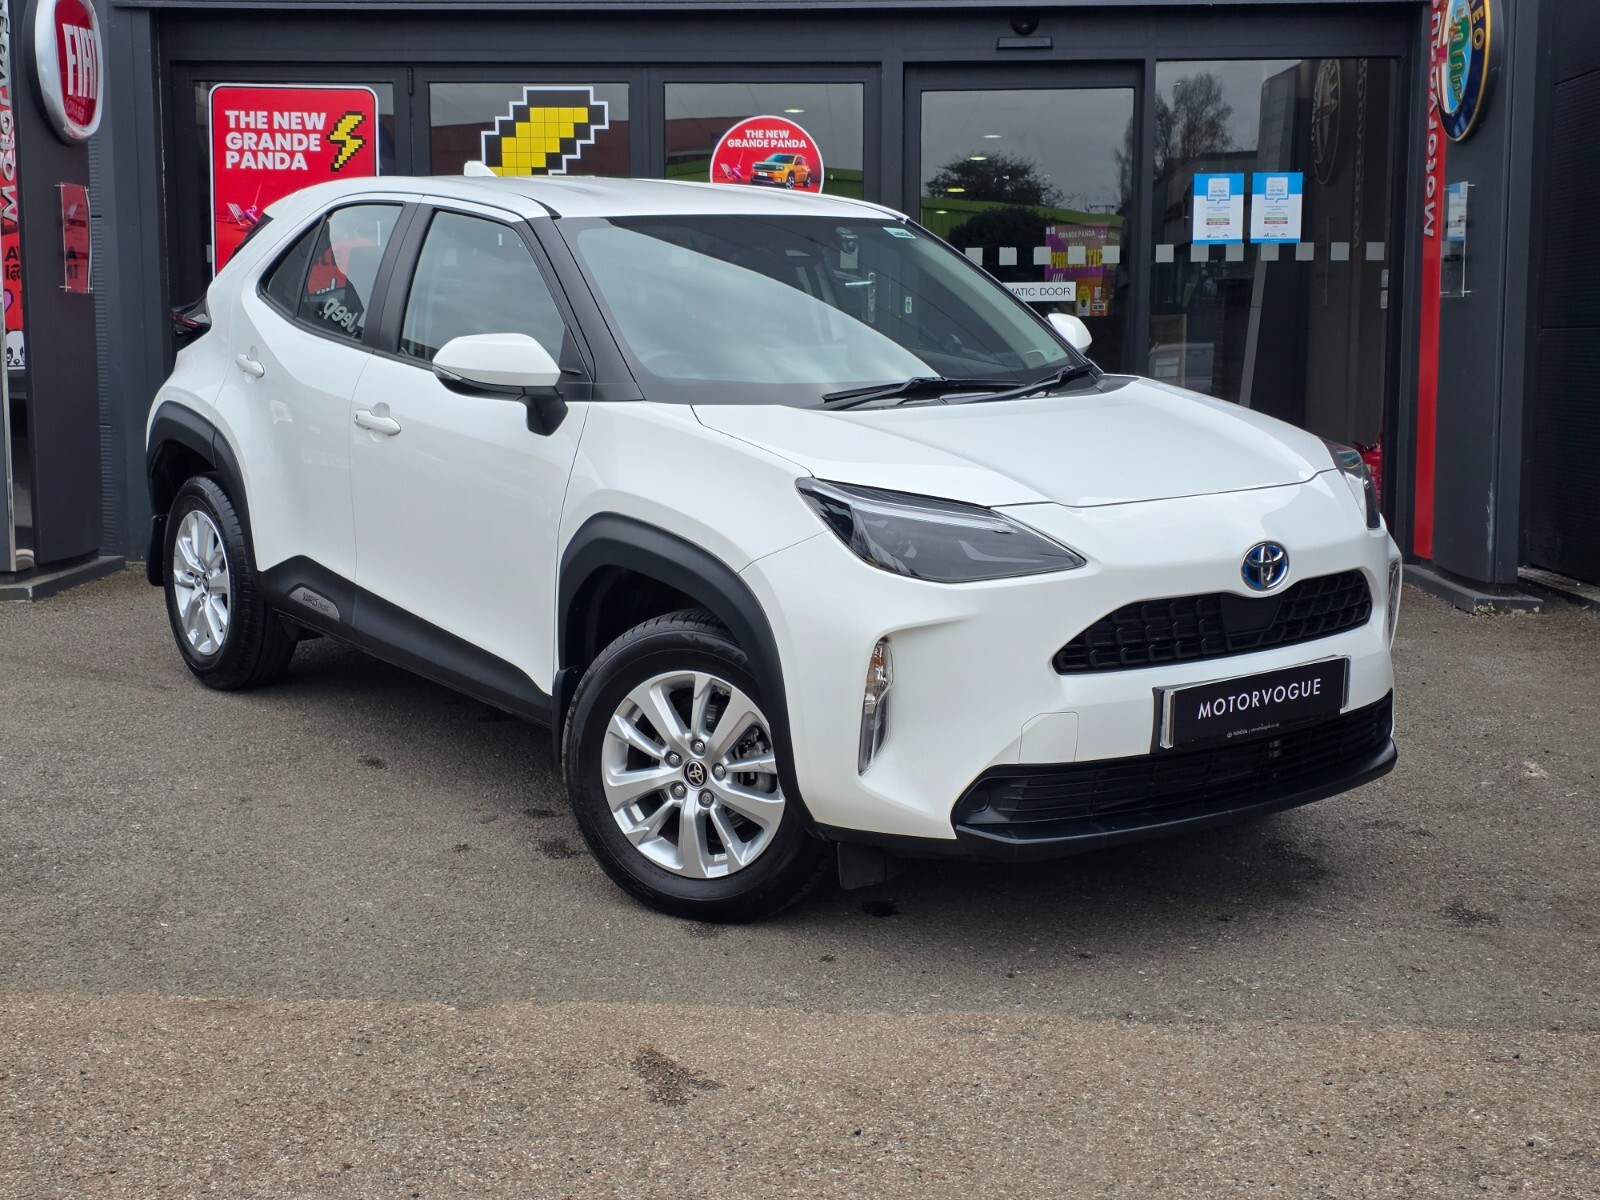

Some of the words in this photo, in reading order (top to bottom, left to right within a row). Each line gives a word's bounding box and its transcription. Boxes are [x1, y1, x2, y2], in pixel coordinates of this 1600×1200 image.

[62, 23, 97, 100] FIAT
[225, 110, 268, 129] THE
[273, 112, 326, 130] NEW
[225, 132, 321, 152] GRANDE
[727, 139, 769, 147] GRANDE
[771, 139, 807, 148] PANDA
[745, 130, 764, 139] THE
[766, 130, 790, 139] NEW
[225, 151, 308, 170] PANDA
[1039, 286, 1071, 297] DOOR
[1197, 678, 1322, 720] MOTORVOGUE
